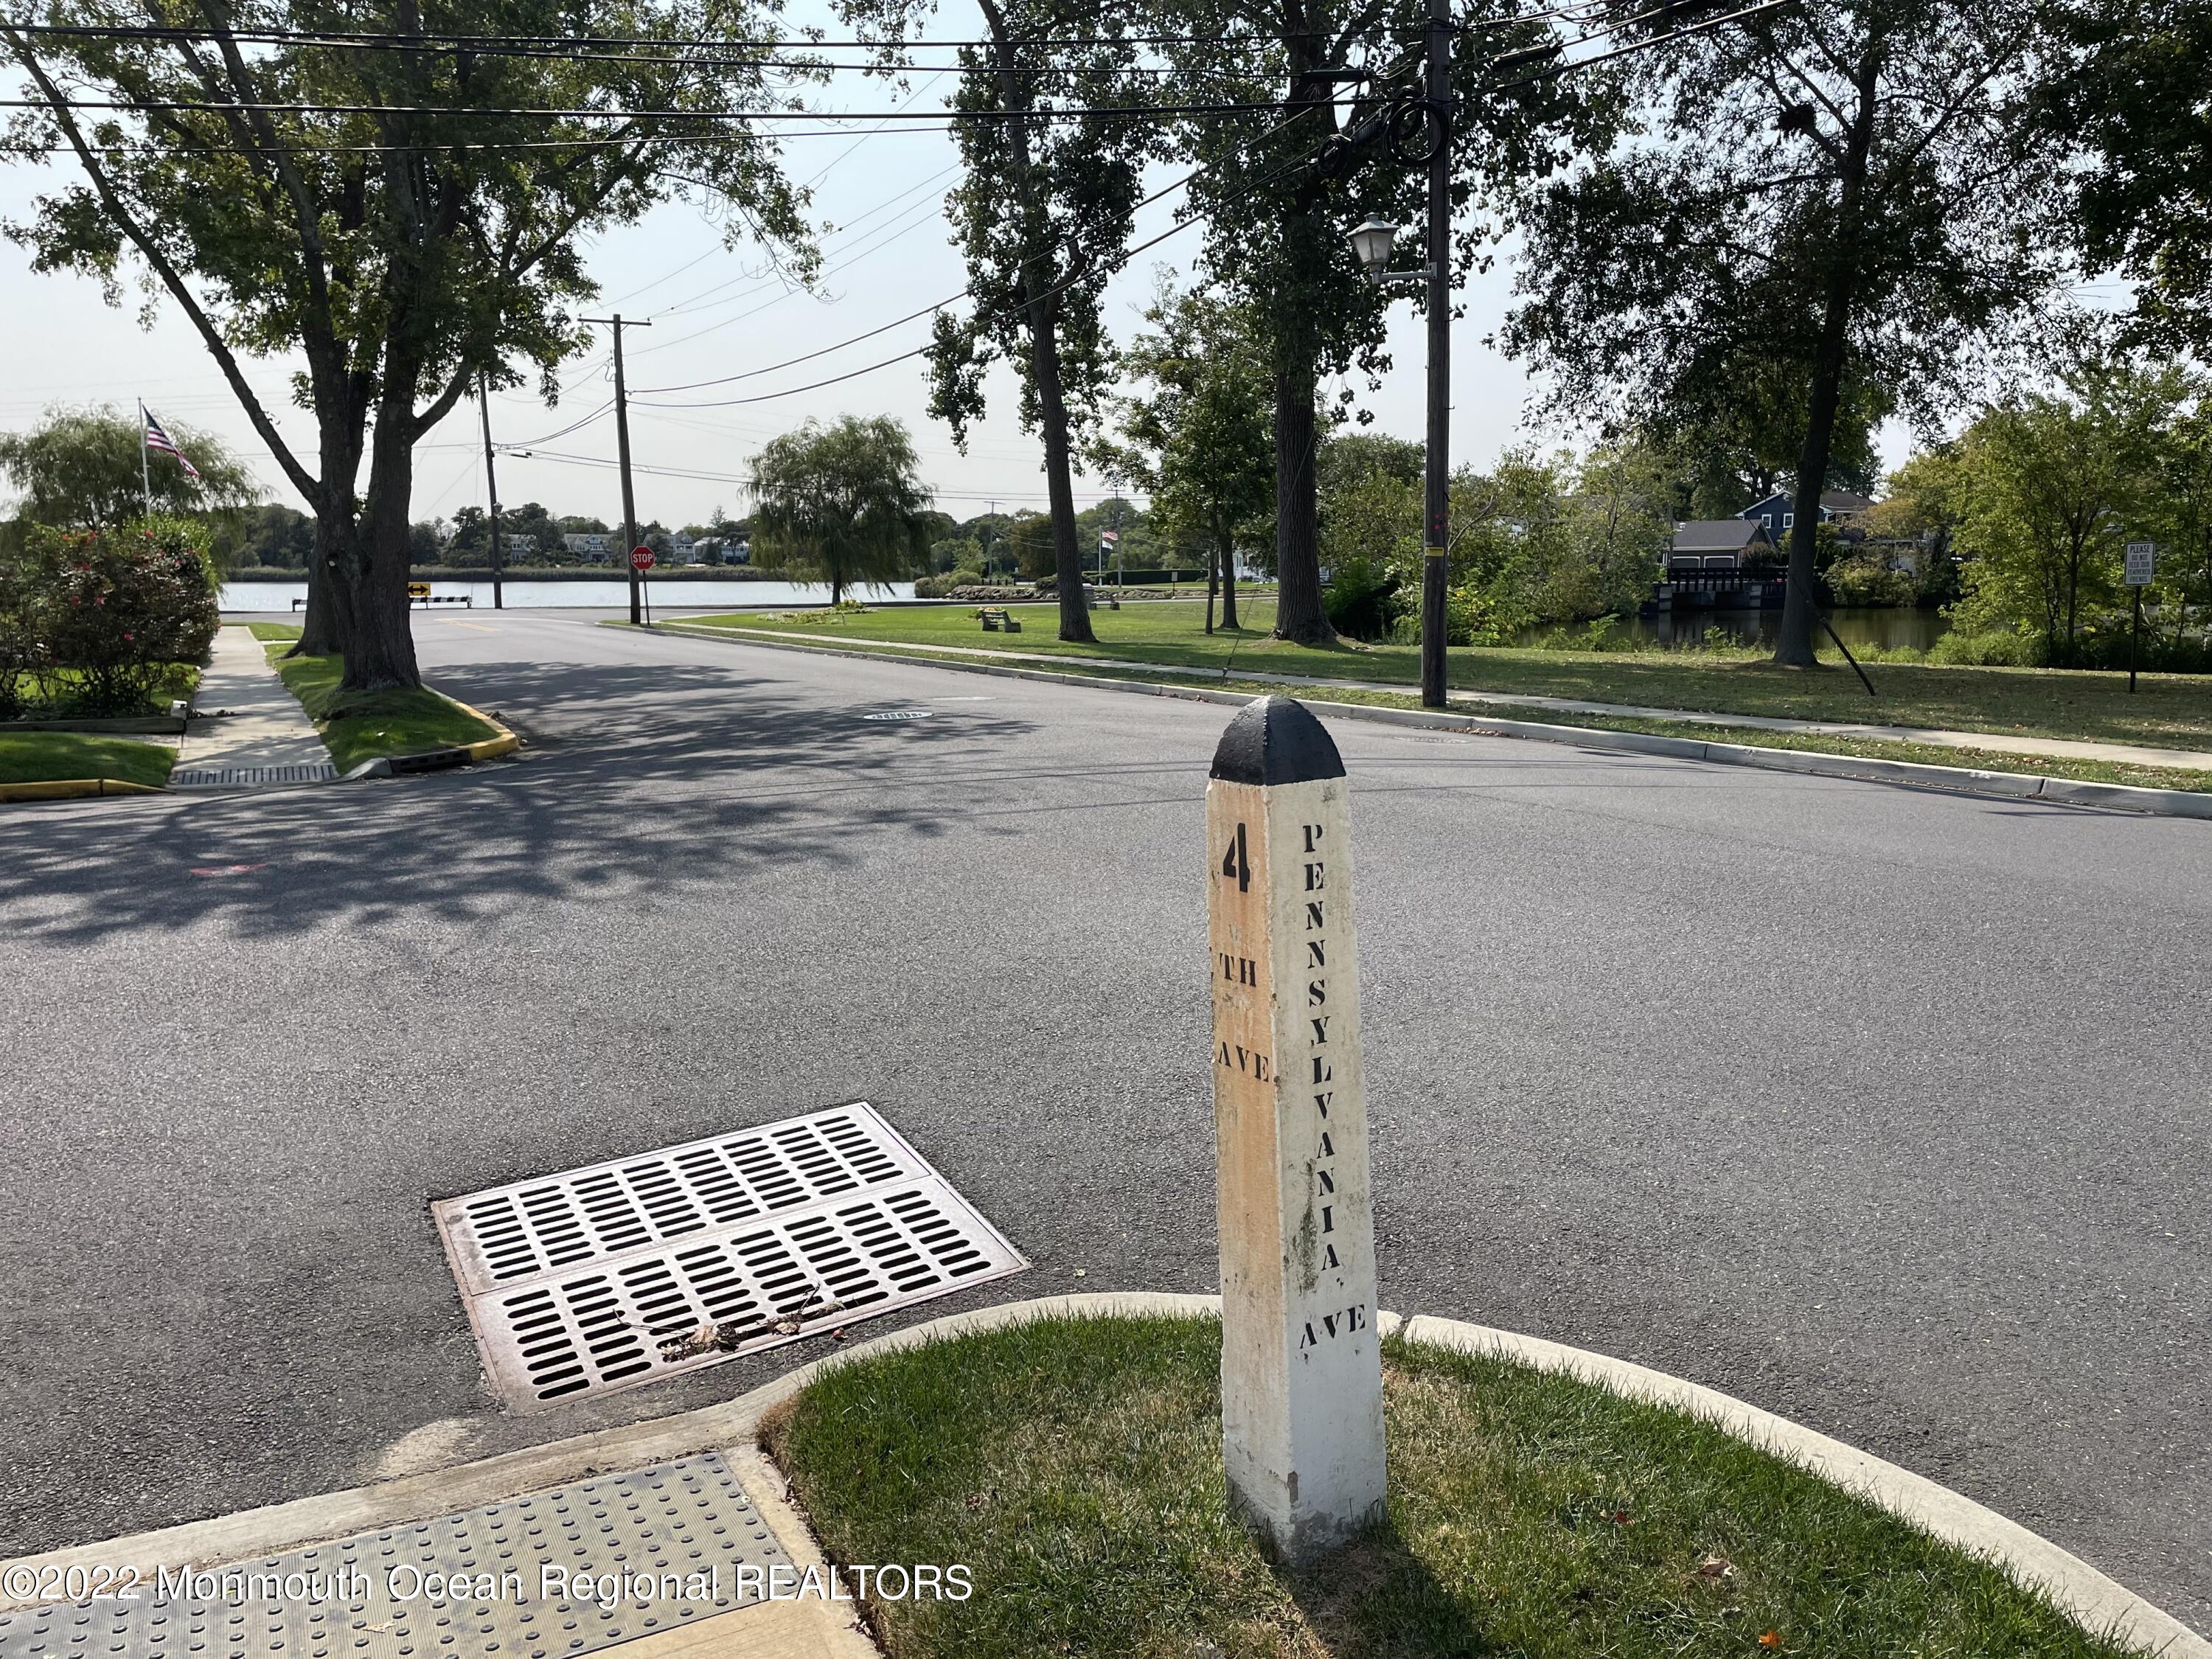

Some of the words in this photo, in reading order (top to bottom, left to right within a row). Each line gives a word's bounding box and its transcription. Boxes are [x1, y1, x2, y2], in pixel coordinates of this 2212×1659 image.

[633, 553, 653, 563] STOP
[2129, 545, 2151, 554] PLEASE
[1222, 822, 1251, 893] 4
[1219, 953, 1257, 987] TH
[1217, 1041, 1270, 1083] AVE
[1302, 824, 1340, 1272] PENNSYLVANIA
[1299, 1304, 1366, 1349] AVE
